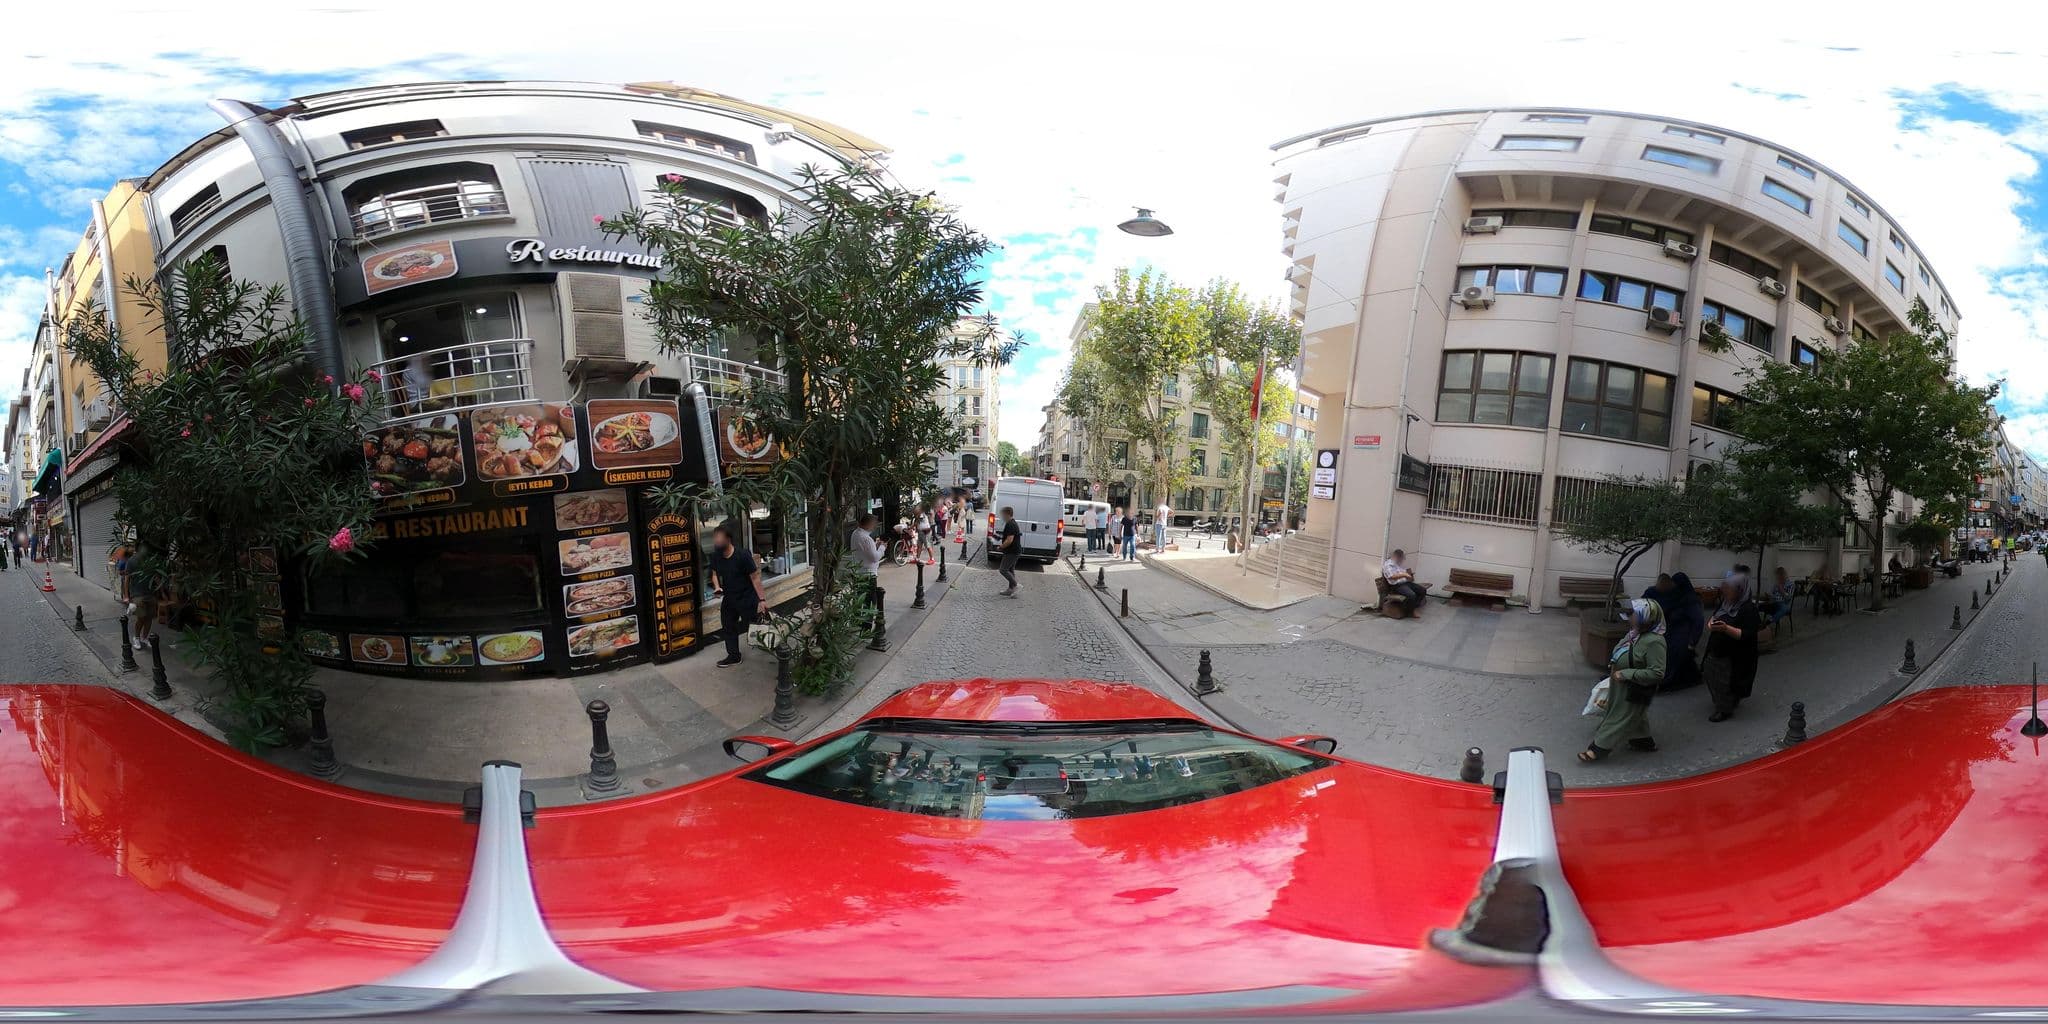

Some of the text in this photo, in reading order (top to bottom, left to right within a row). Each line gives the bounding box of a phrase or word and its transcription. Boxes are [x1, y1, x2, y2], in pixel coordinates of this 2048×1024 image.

[23, 439, 32, 494] HOTL
[394, 506, 529, 538] RESTAURANT
[651, 540, 667, 652] RESTAURANT
